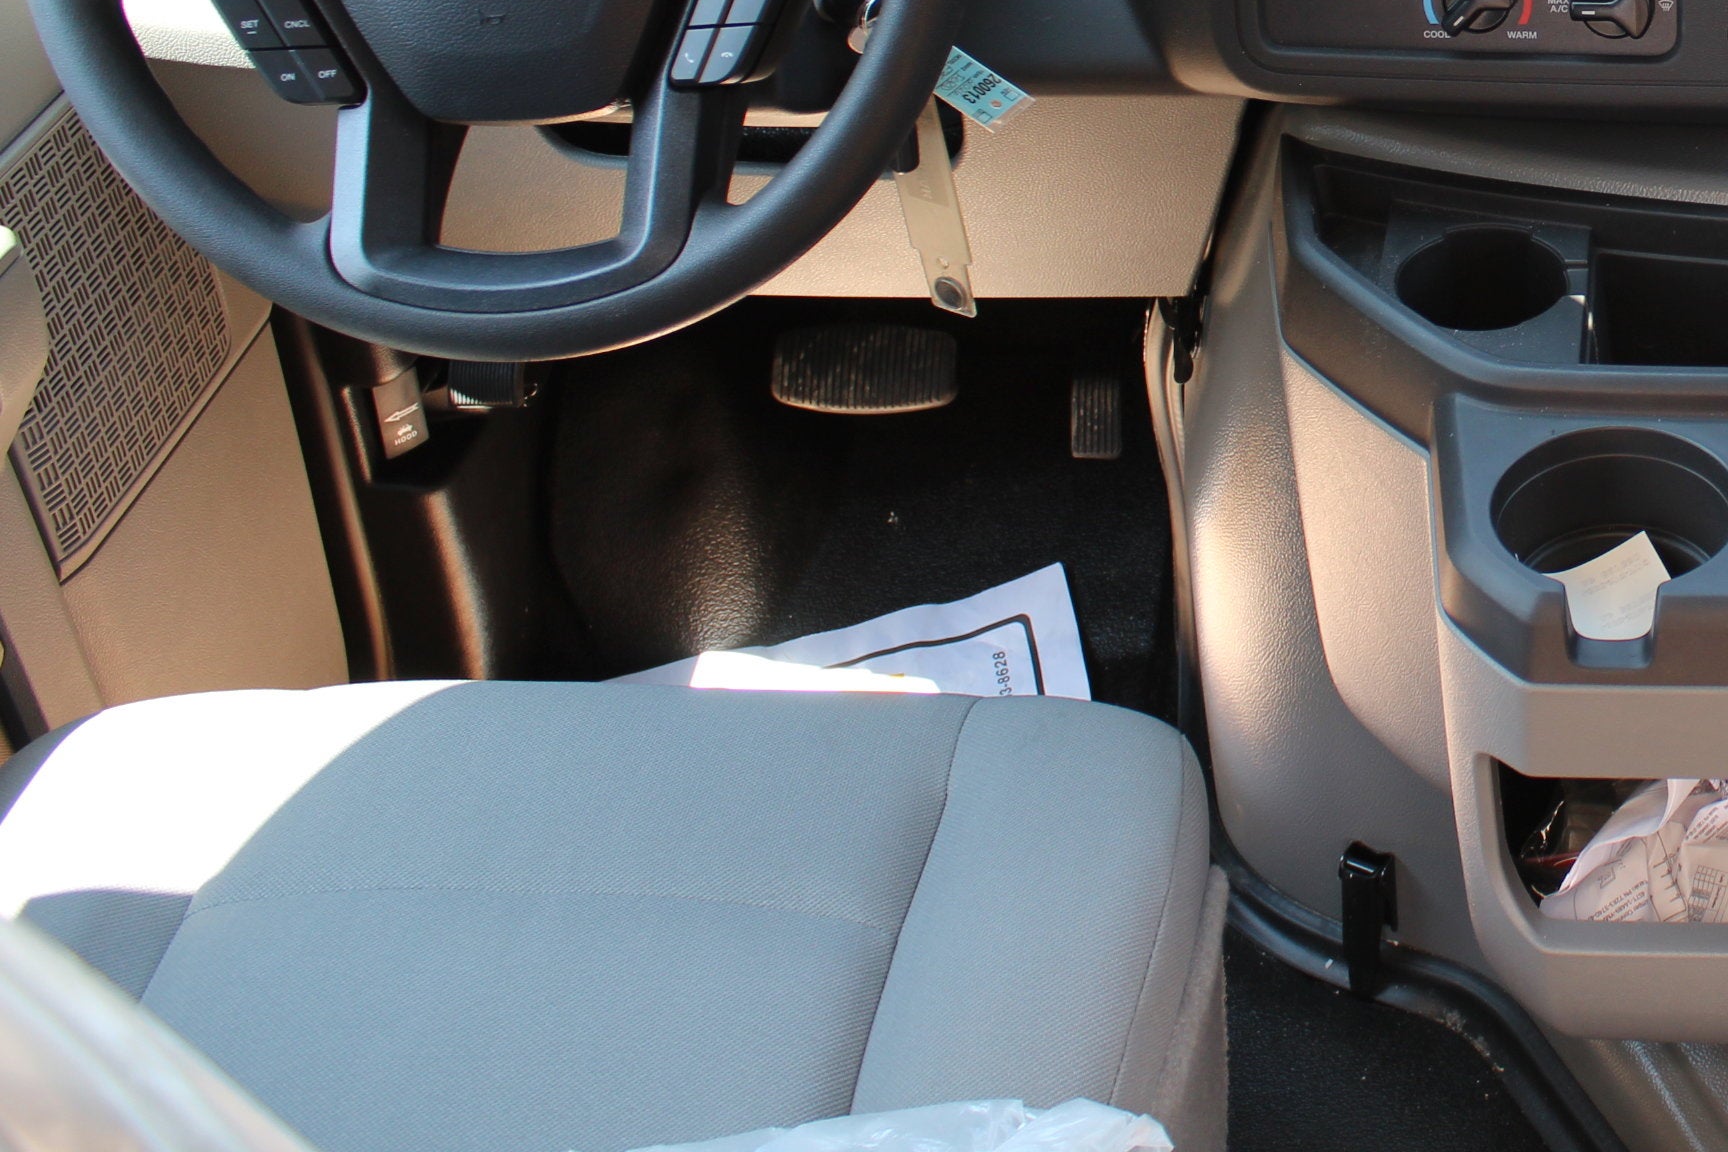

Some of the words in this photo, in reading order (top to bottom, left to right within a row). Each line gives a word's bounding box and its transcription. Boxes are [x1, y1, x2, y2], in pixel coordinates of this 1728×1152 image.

[1550, 4, 1568, 14] A/C
[240, 20, 259, 29] SET
[284, 20, 310, 29] CNCL
[1423, 30, 1451, 39] COOL
[1507, 30, 1537, 39] WARM
[280, 73, 295, 81] ON
[318, 69, 337, 79] OFF
[961, 73, 1002, 105] 260013
[394, 430, 417, 446] HOOD
